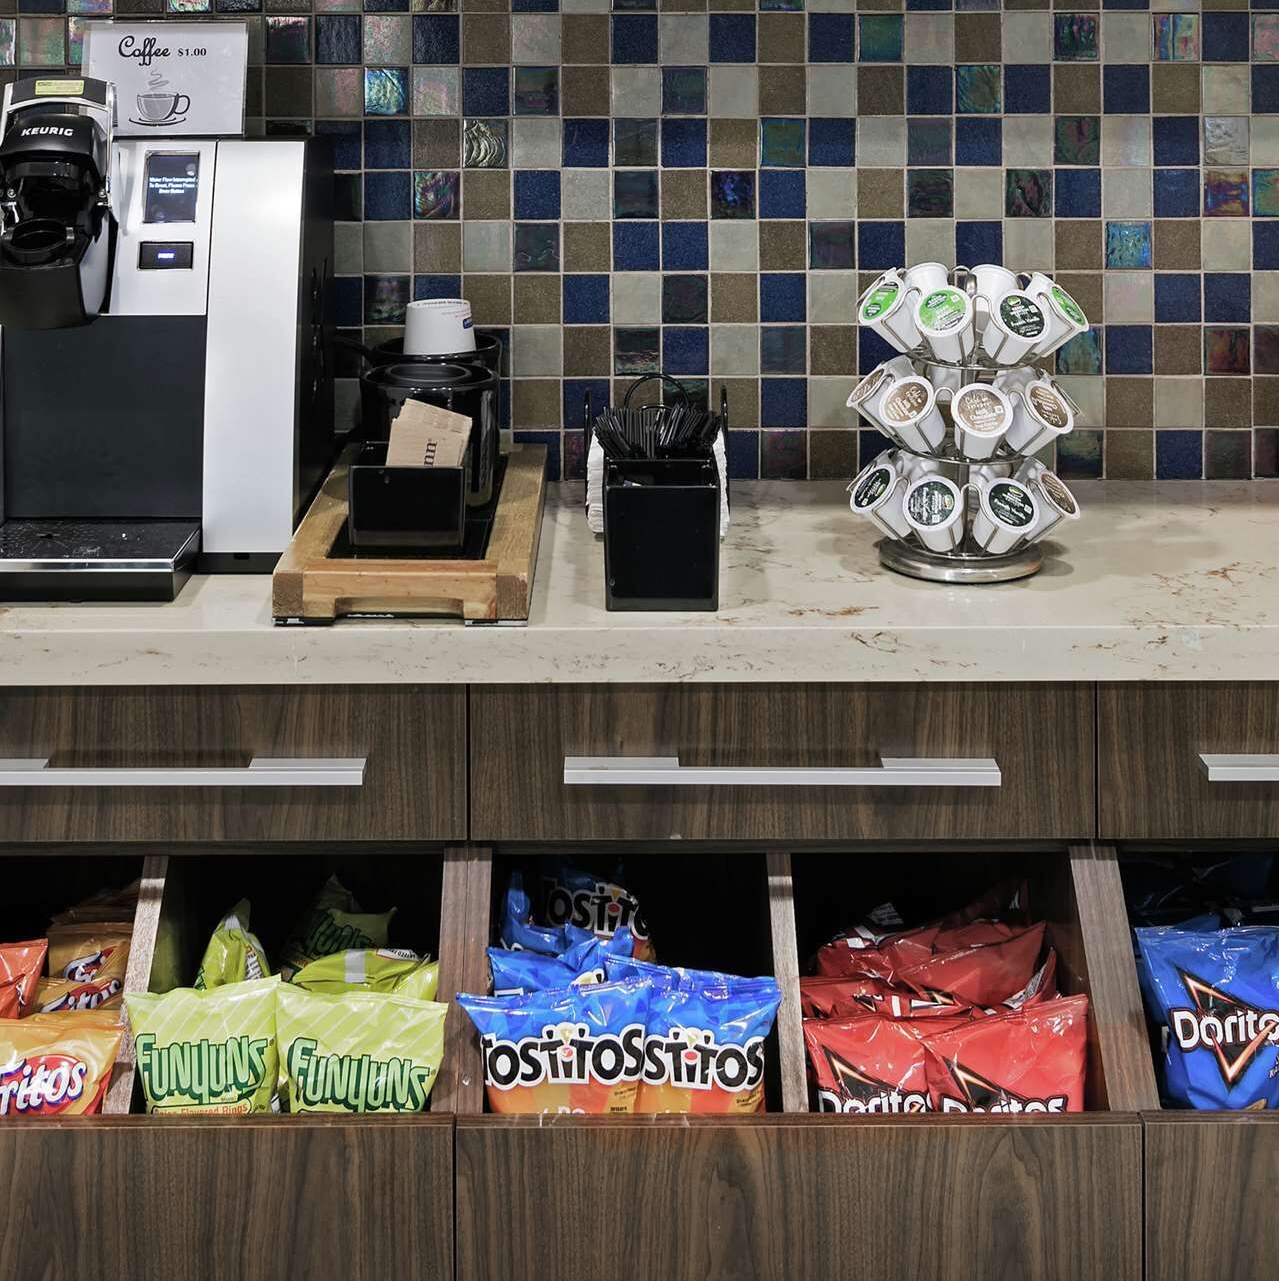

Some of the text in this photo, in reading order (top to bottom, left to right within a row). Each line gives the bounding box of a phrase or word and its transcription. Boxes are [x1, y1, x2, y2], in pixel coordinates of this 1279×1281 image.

[118, 34, 207, 66] Coffee $1.00
[21, 126, 74, 137] KEURIG
[134, 1032, 269, 1106] FUNYUNS
[642, 1026, 765, 1092] STITOS
[222, 1103, 248, 1115] Rings
